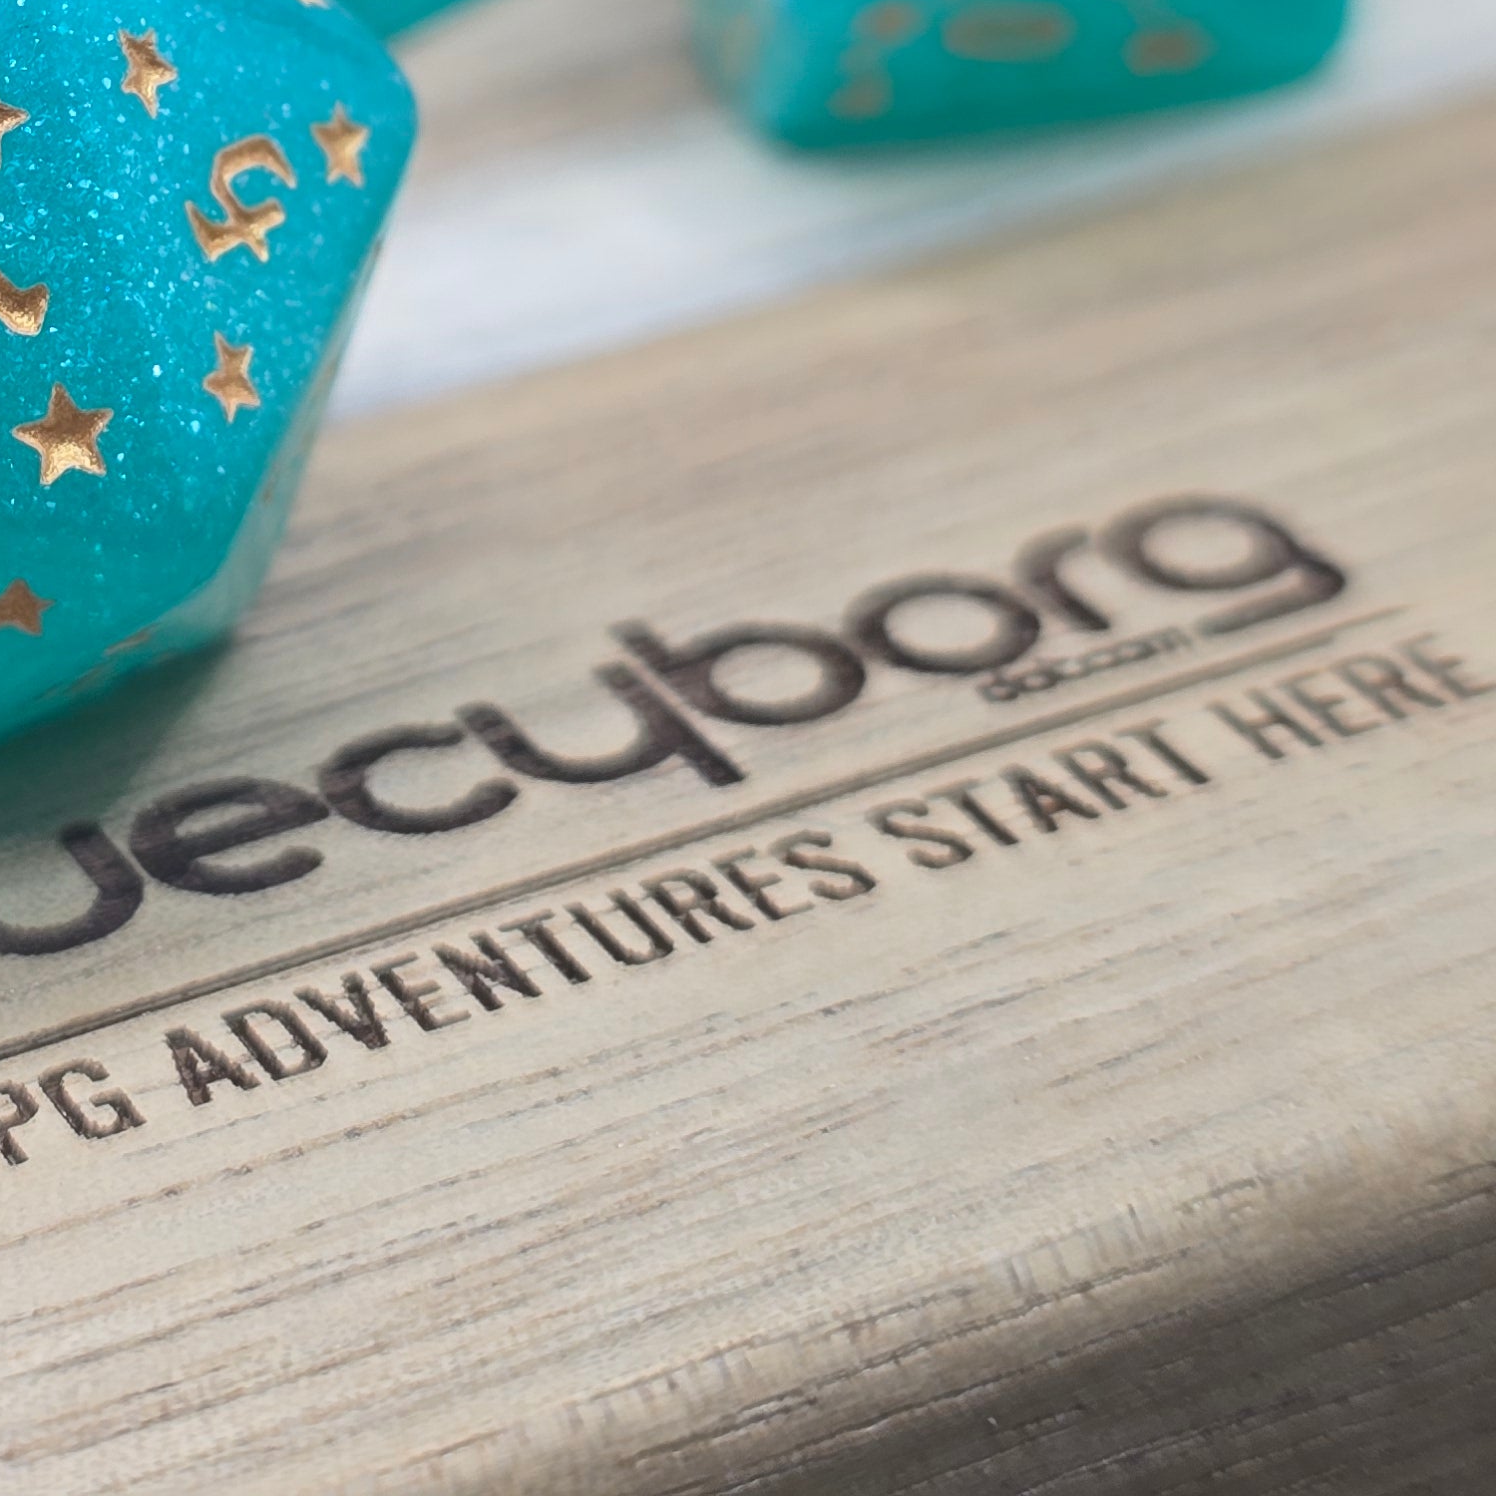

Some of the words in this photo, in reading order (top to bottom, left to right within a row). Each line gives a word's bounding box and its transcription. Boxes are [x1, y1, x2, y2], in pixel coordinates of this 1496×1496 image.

[164, 830, 877, 1104] ADVENTURES
[866, 715, 1212, 870] START
[1207, 631, 1496, 760] HERE
